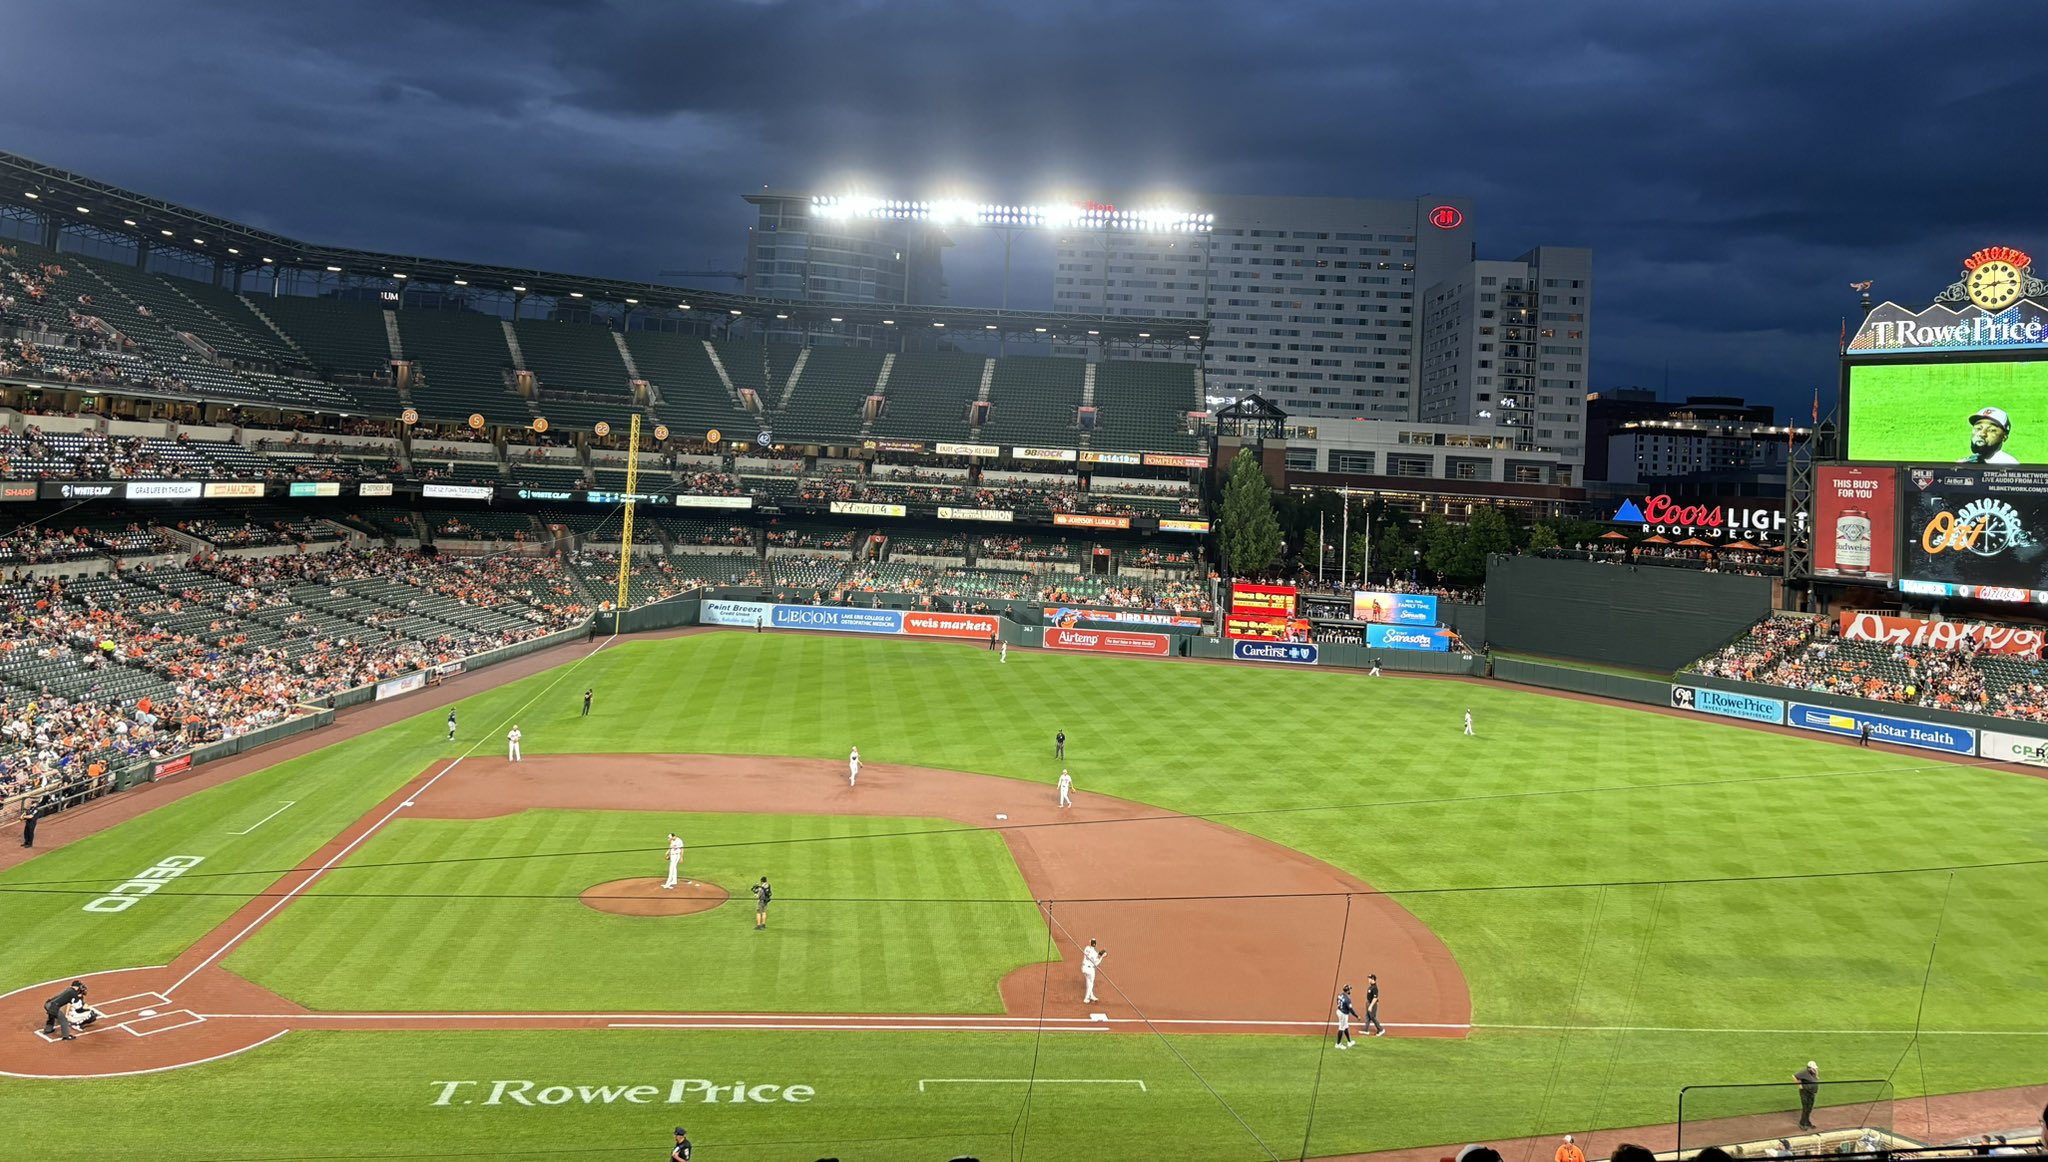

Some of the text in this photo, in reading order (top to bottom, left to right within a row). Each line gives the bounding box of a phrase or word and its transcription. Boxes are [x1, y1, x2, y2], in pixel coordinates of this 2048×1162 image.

[1871, 317, 2042, 346] T. Rowe Price
[74, 486, 94, 495] WHITE
[1833, 479, 1878, 489] THIS BUD'S
[1838, 488, 1873, 498] FOR YOU
[982, 509, 1012, 520] UNION
[1644, 494, 1724, 527] Coors
[1727, 508, 1808, 530] LIGHT
[1642, 524, 1769, 541] ROOF DECK
[708, 603, 763, 613] Point Breeze
[910, 618, 992, 632] weis markets
[1143, 614, 1171, 624] BATH
[1058, 631, 1098, 644] Airtemp
[1382, 628, 1431, 644] Sarasota
[1242, 644, 1288, 658] CareFirst
[1701, 691, 1773, 714] T. Rowe Price
[1910, 730, 1954, 745] Health
[82, 855, 205, 912] GEICO
[429, 1078, 816, 1107] T. Rowe Price
